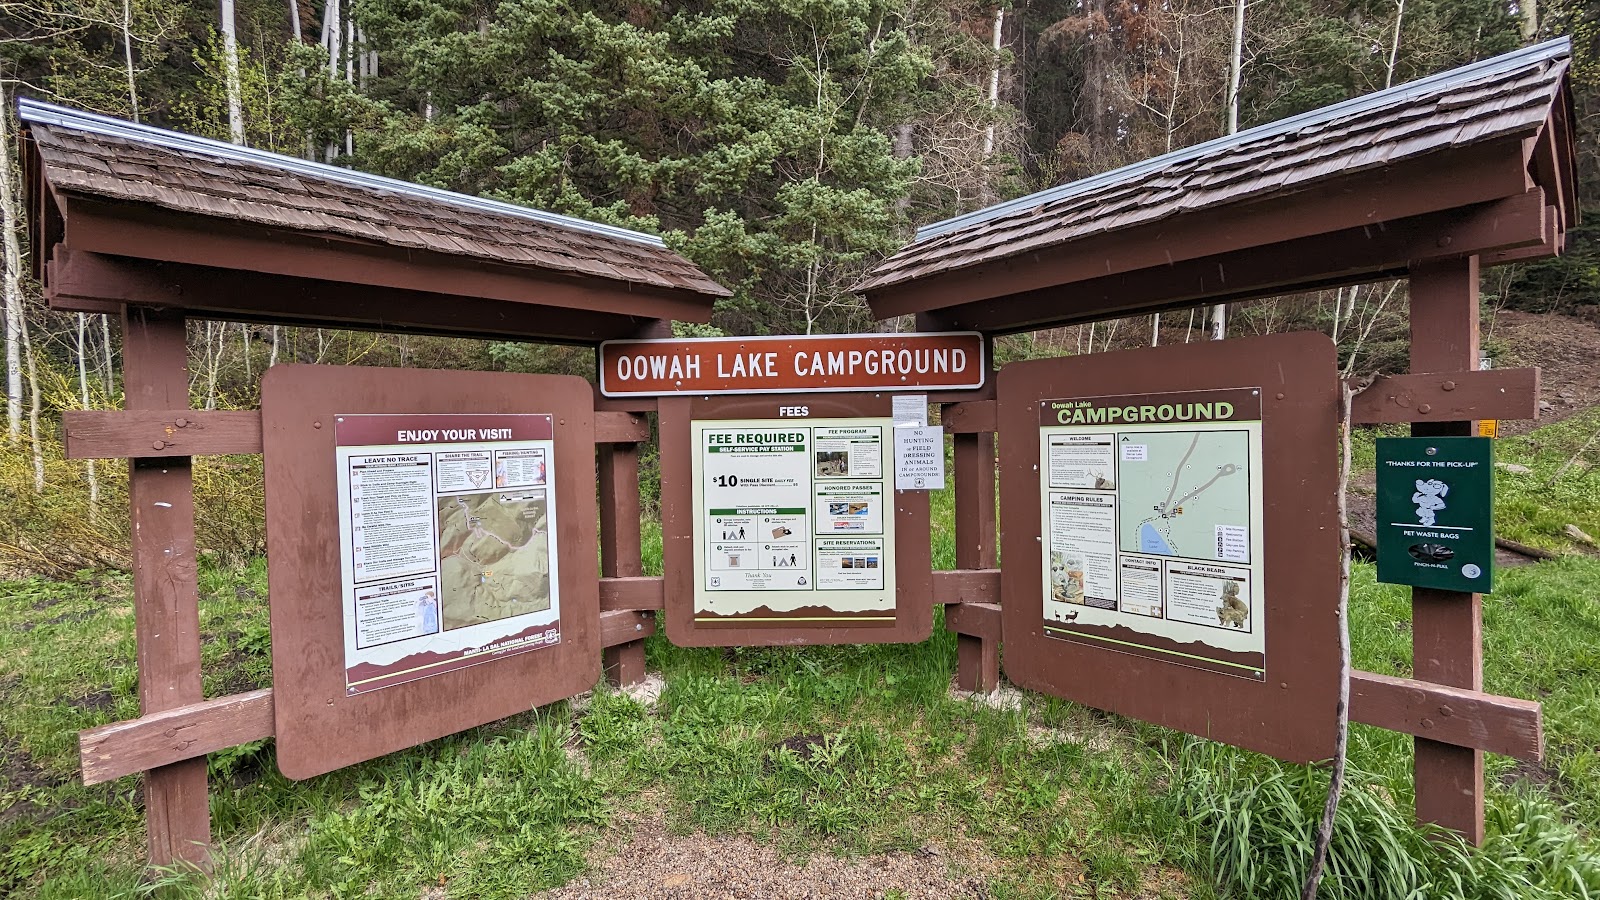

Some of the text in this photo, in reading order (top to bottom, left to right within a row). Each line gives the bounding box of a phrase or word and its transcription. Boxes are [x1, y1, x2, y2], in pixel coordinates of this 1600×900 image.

[617, 348, 966, 381] OOWAH LAKE CAMPGROUND
[779, 406, 810, 417] FEES
[1057, 402, 1234, 424] CAMPGROUND
[398, 429, 512, 442] ENJOY YOUR VISIT!
[709, 433, 805, 444] FEE REQUIRED
[713, 475, 738, 487] $10
[500, 637, 524, 648] NATIONAL
[525, 633, 543, 642] FOREST
